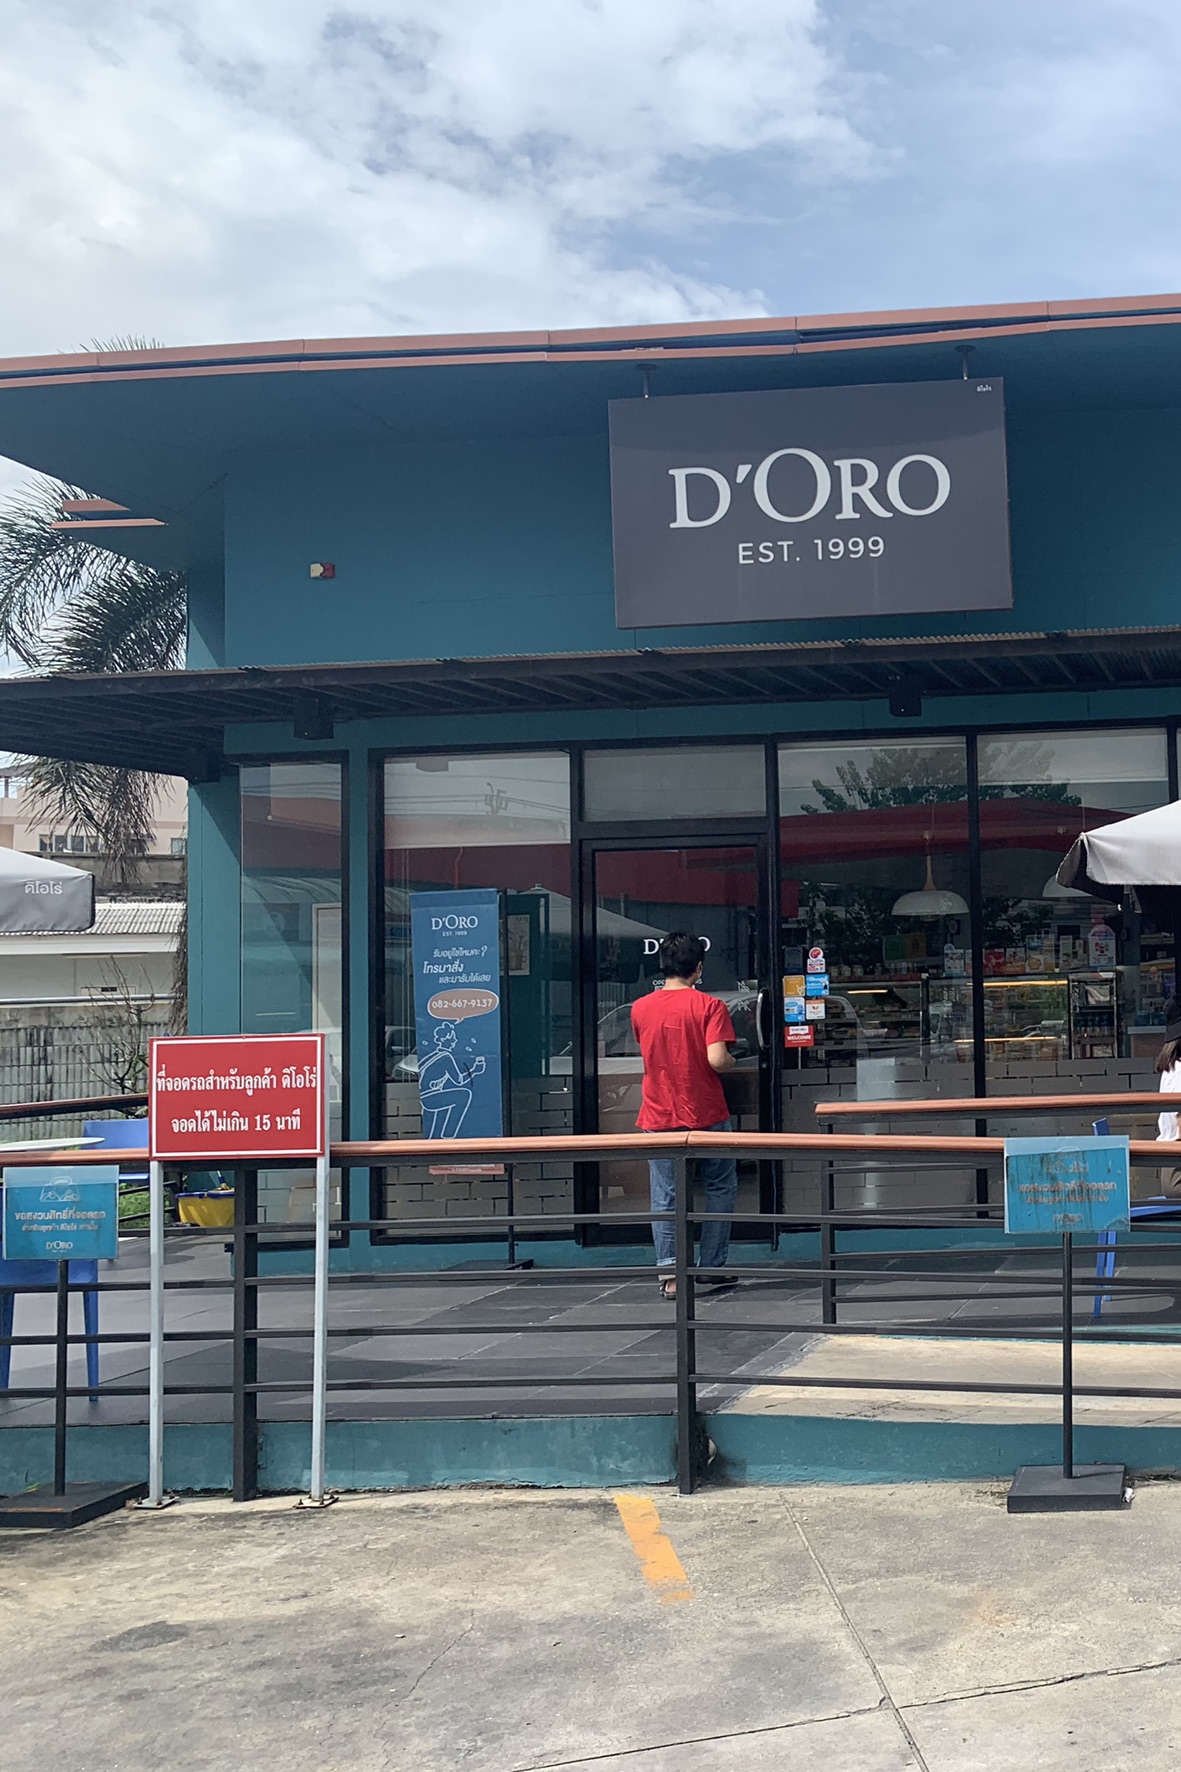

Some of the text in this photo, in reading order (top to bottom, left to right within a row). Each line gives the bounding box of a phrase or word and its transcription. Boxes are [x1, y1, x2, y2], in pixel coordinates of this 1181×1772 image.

[668, 447, 951, 529] D'ORO
[738, 535, 885, 565] EST. 1999
[431, 914, 479, 930] D'ORO
[431, 998, 493, 1009] 082-667-9137
[156, 1064, 277, 1096] ที่จอดรถสำหรับลูกค้า
[255, 1114, 271, 1131] 15
[275, 1108, 301, 1130] นาที
